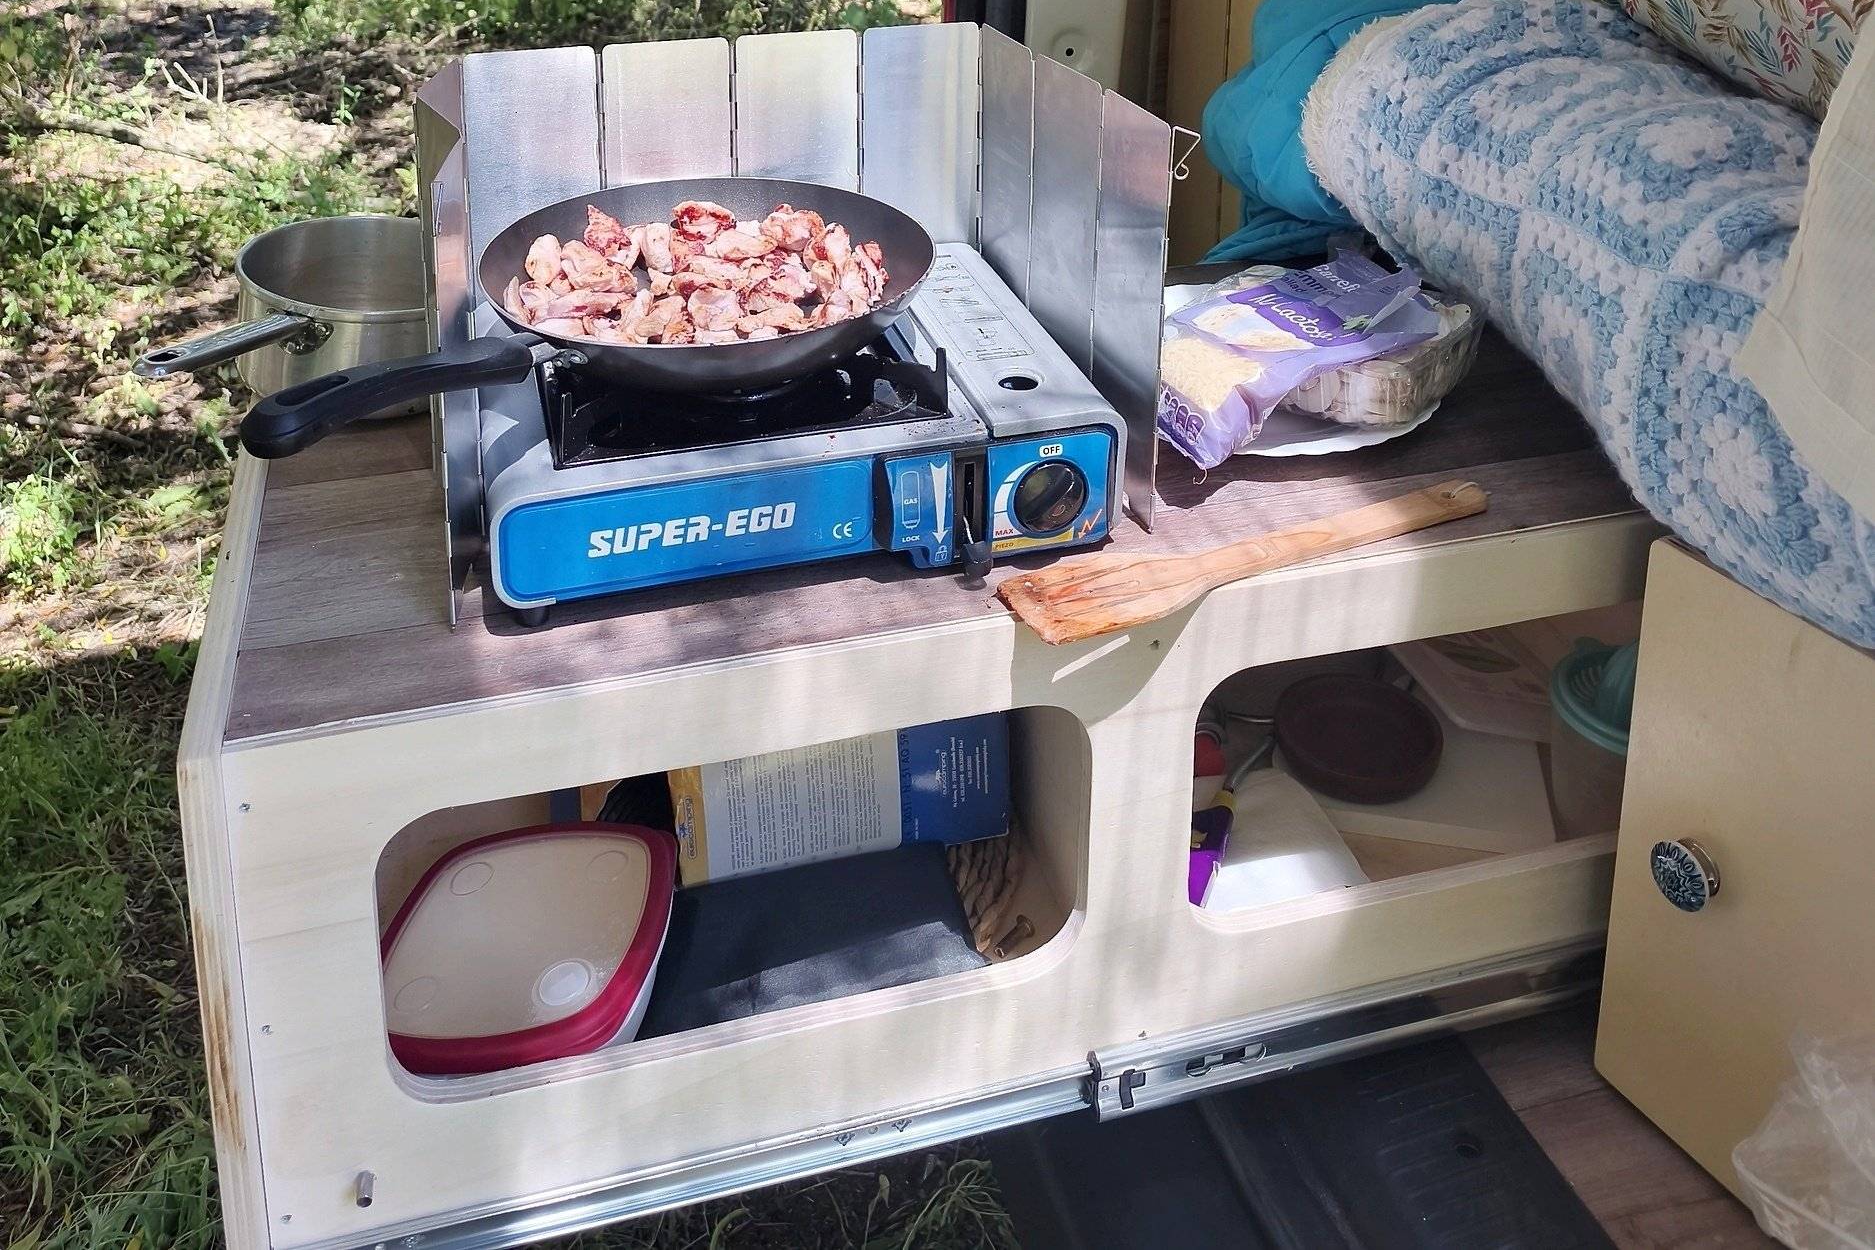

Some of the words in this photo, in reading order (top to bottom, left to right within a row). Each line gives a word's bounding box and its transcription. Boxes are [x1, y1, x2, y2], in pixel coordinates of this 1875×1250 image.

[1043, 445, 1061, 455] OFF
[588, 501, 797, 559] SUPER-EGO
[995, 528, 1014, 536] MAX
[902, 535, 920, 543] LOCK
[994, 542, 1015, 550] PIEZO
